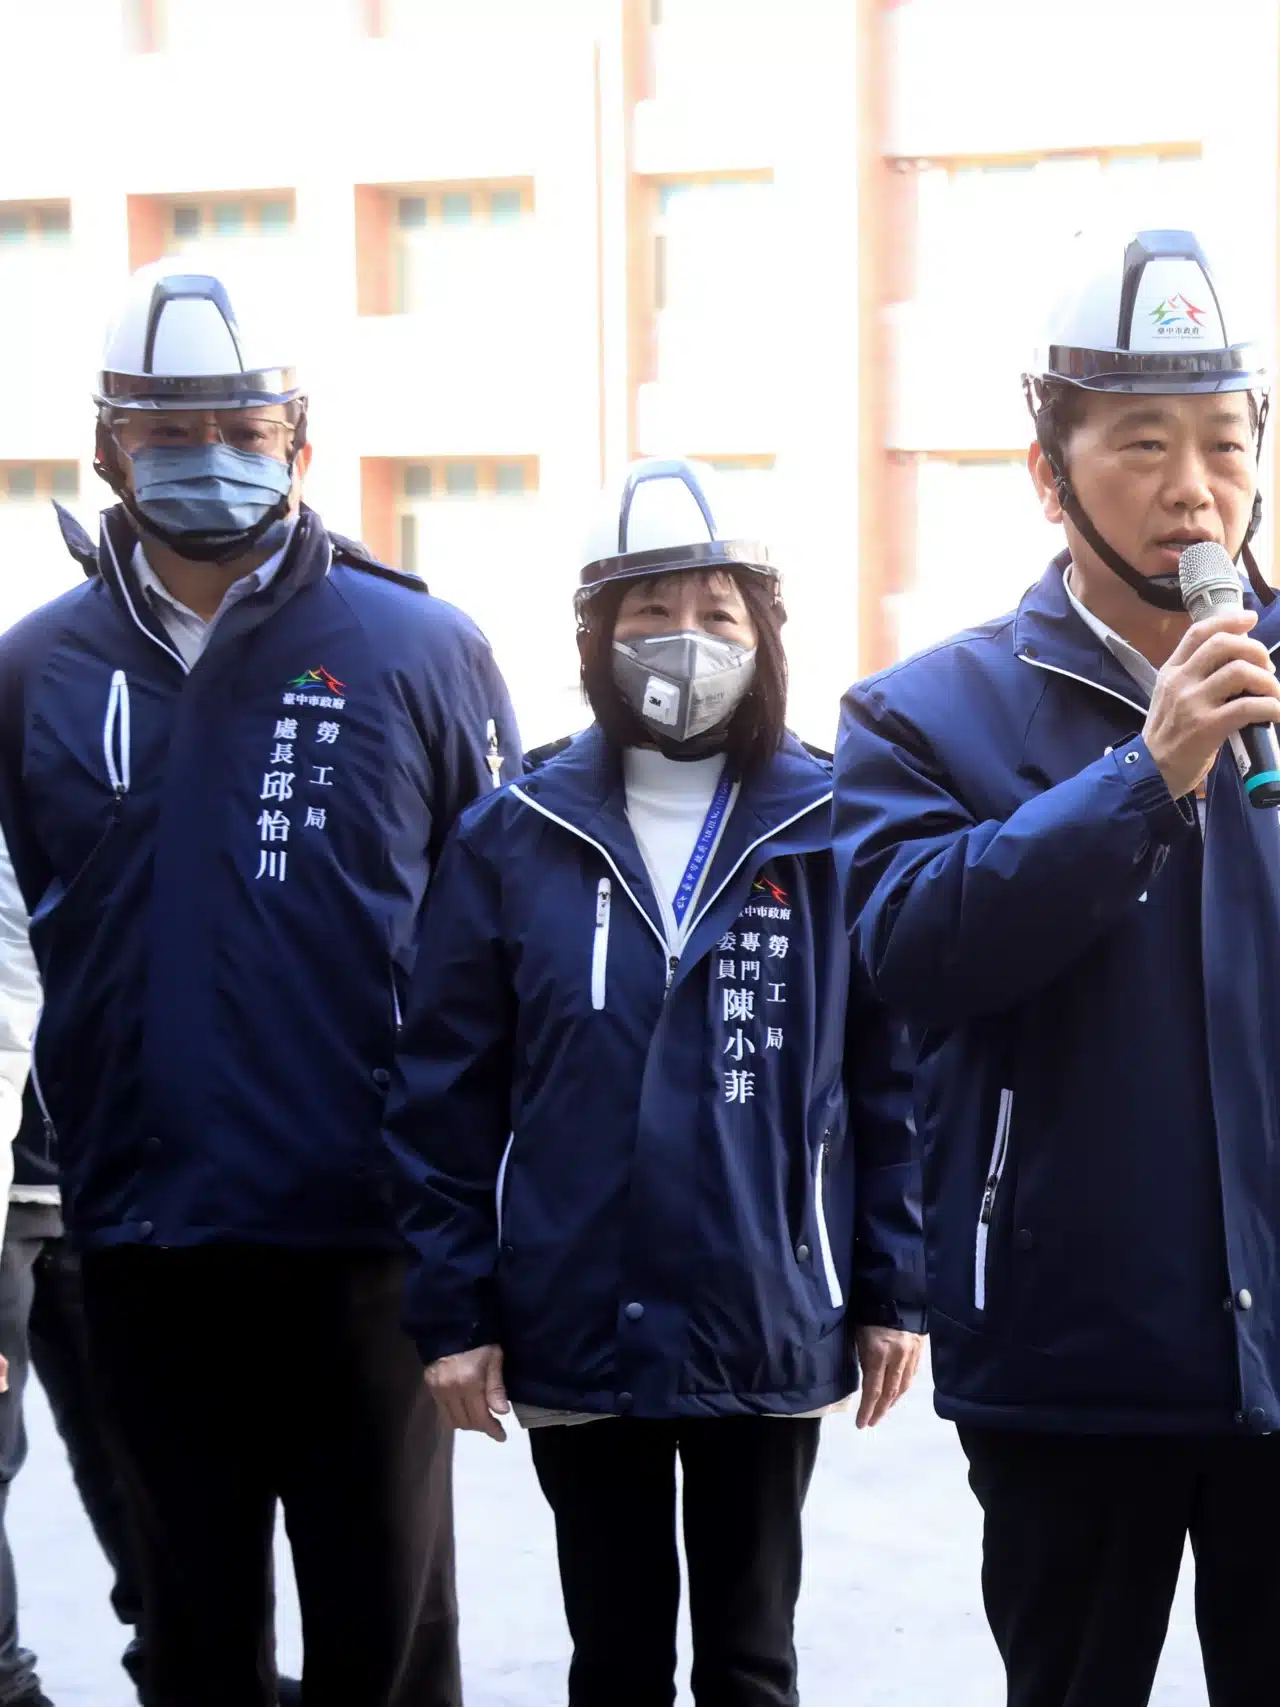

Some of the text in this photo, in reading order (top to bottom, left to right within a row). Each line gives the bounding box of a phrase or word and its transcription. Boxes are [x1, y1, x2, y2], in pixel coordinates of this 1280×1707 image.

[283, 692, 346, 710] 臺中市政府
[649, 696, 662, 707] 3M
[255, 717, 298, 882] 處長邱怡川
[304, 720, 341, 830] 勞工局
[716, 931, 737, 980] 委員
[740, 931, 761, 981] 專門
[765, 934, 789, 1050] 勞工局
[722, 987, 756, 1104] 陳小菲
